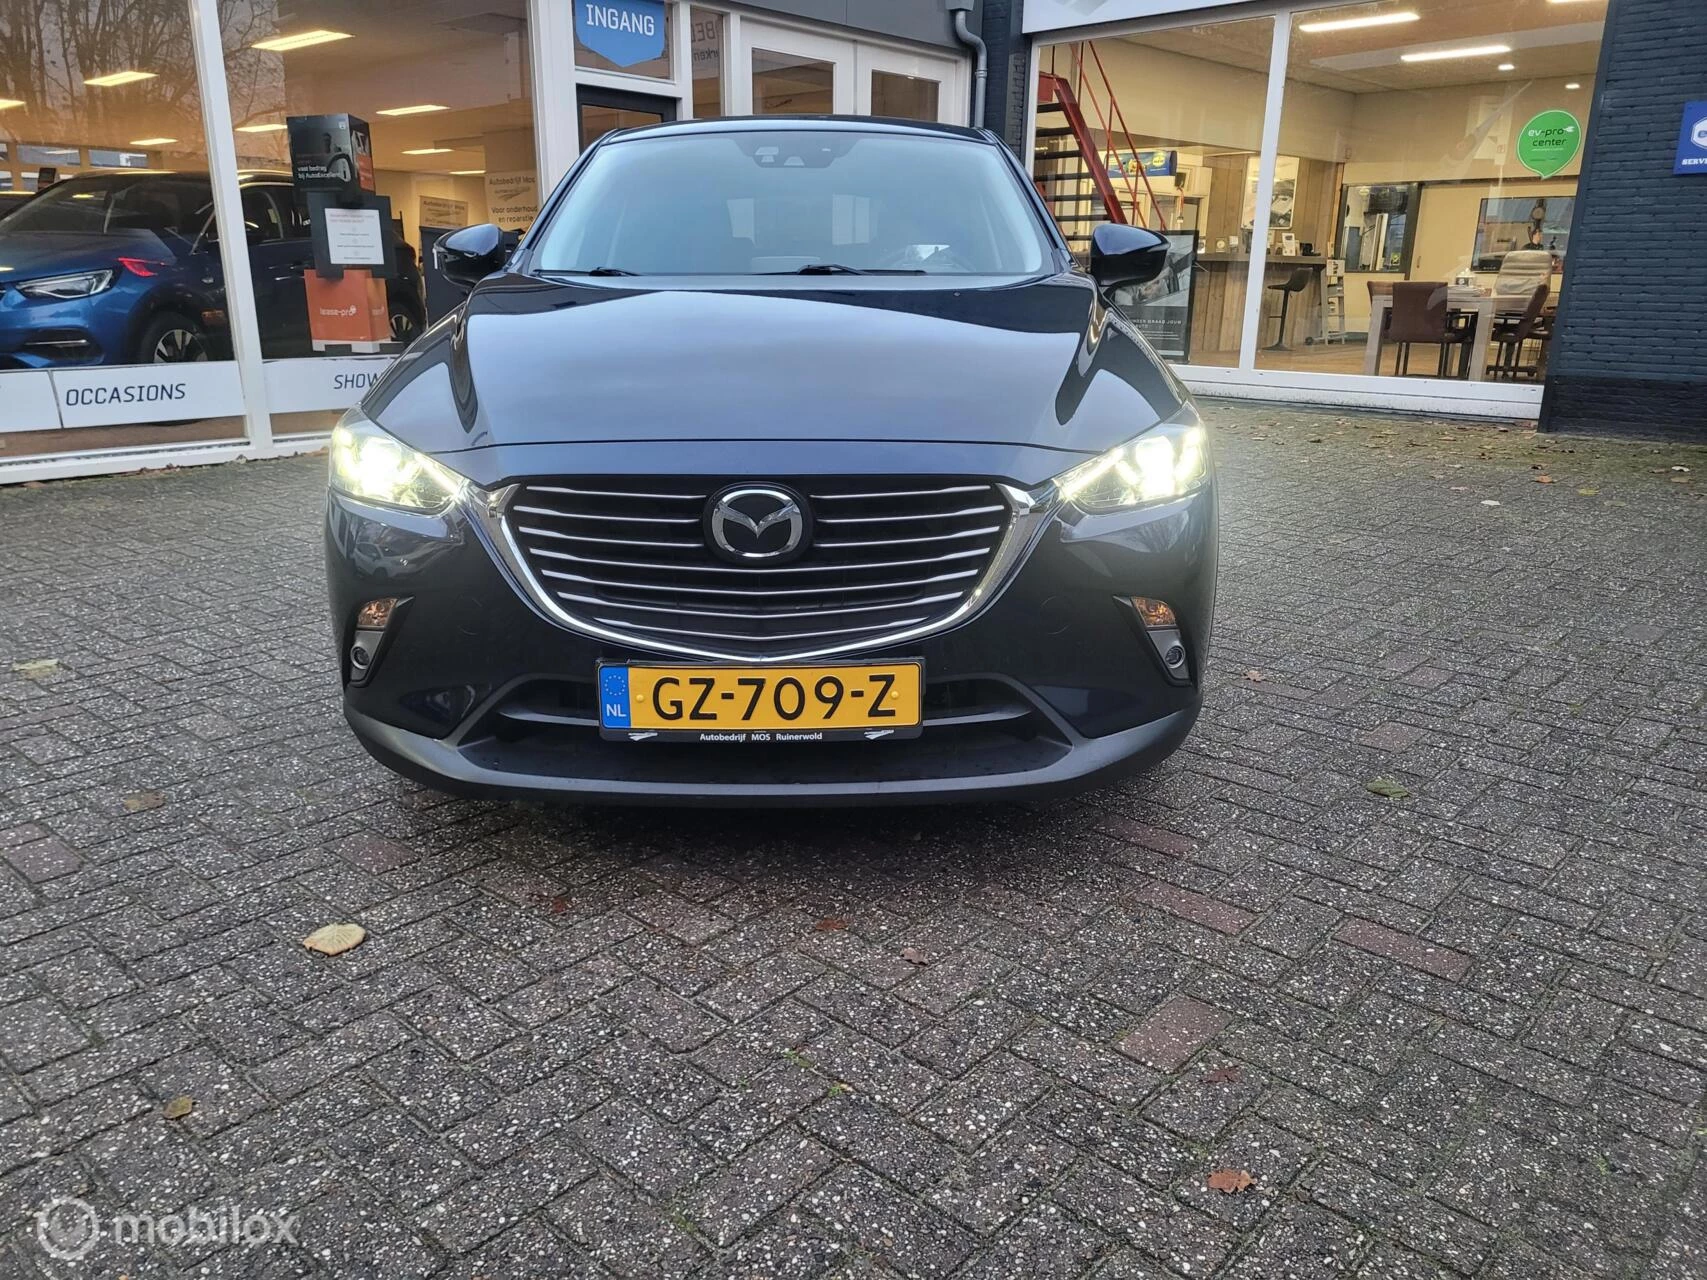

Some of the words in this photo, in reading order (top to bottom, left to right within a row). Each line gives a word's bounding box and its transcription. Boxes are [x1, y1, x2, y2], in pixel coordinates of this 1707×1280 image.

[586, 4, 655, 36] INGANG
[1528, 128, 1564, 138] ev-pro
[1532, 138, 1567, 147] center
[333, 372, 379, 390] SHOW
[66, 383, 186, 406] OCCASIONS
[652, 674, 896, 721] GZ-709-Z
[606, 703, 626, 717] NL
[699, 733, 746, 743] Autobedrijf
[751, 733, 771, 741] MOS
[776, 732, 823, 741] Ruinerwold
